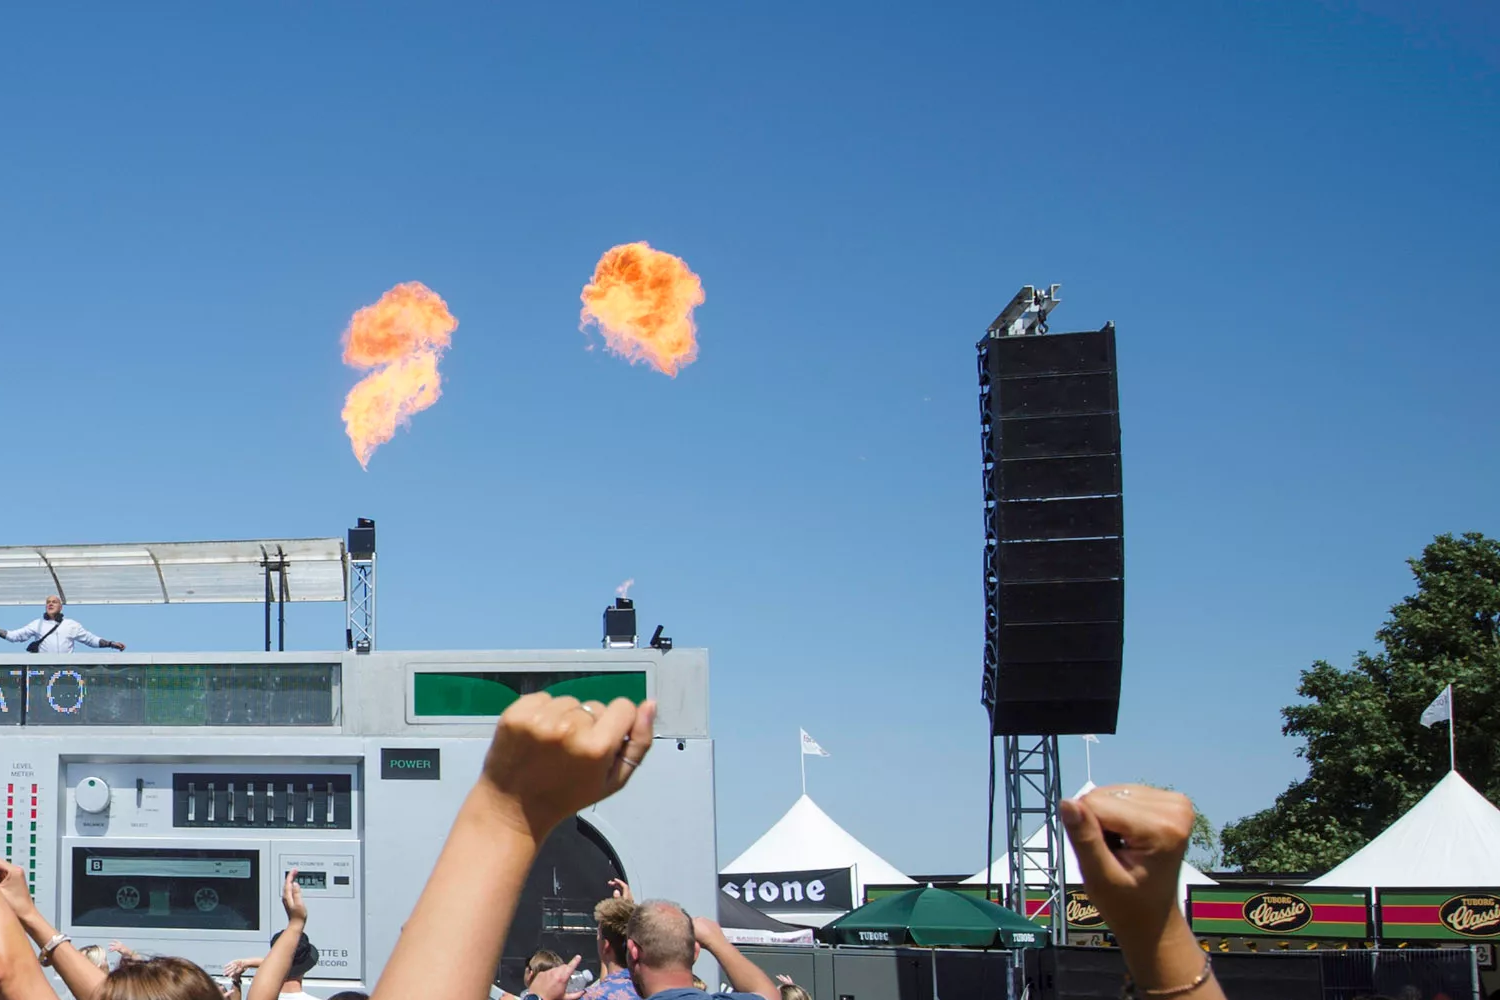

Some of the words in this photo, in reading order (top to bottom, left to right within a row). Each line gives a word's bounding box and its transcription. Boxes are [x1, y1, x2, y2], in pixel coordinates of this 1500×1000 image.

[390, 760, 431, 769] POWER
[93, 861, 101, 870] B
[1263, 896, 1292, 904] TUBORG
[1461, 898, 1496, 906] TUBORG
[1249, 902, 1306, 926] Classic
[1447, 904, 1500, 931] Classi
[341, 949, 348, 958] B
